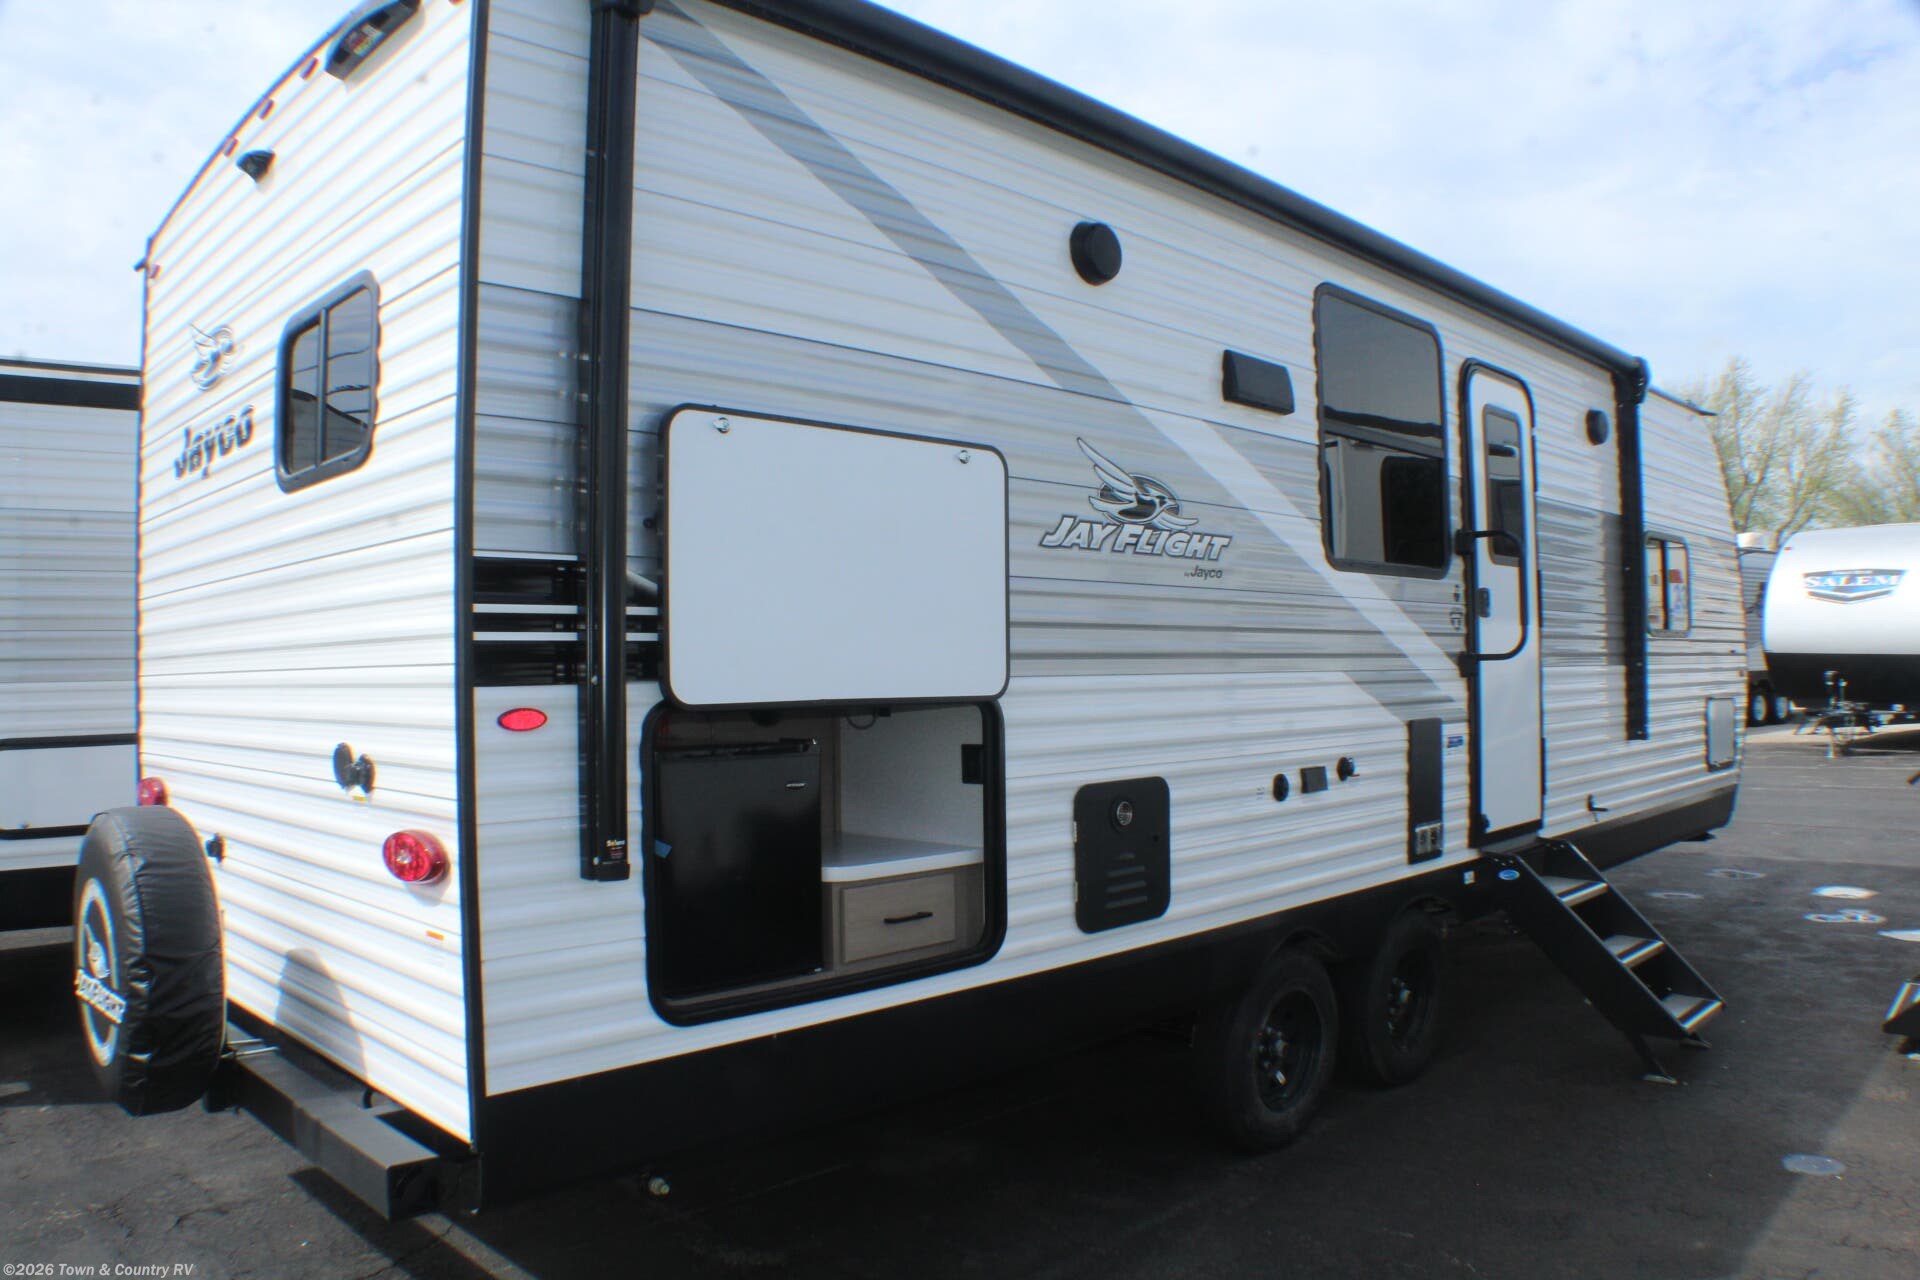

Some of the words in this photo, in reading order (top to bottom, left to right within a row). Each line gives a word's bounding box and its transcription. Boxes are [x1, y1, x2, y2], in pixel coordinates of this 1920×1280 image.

[174, 405, 254, 479] Jayco
[1039, 514, 1121, 550] JAY
[1111, 522, 1232, 561] FLIGHT
[1190, 564, 1223, 581] Jayco
[1803, 573, 1902, 588] SALEM
